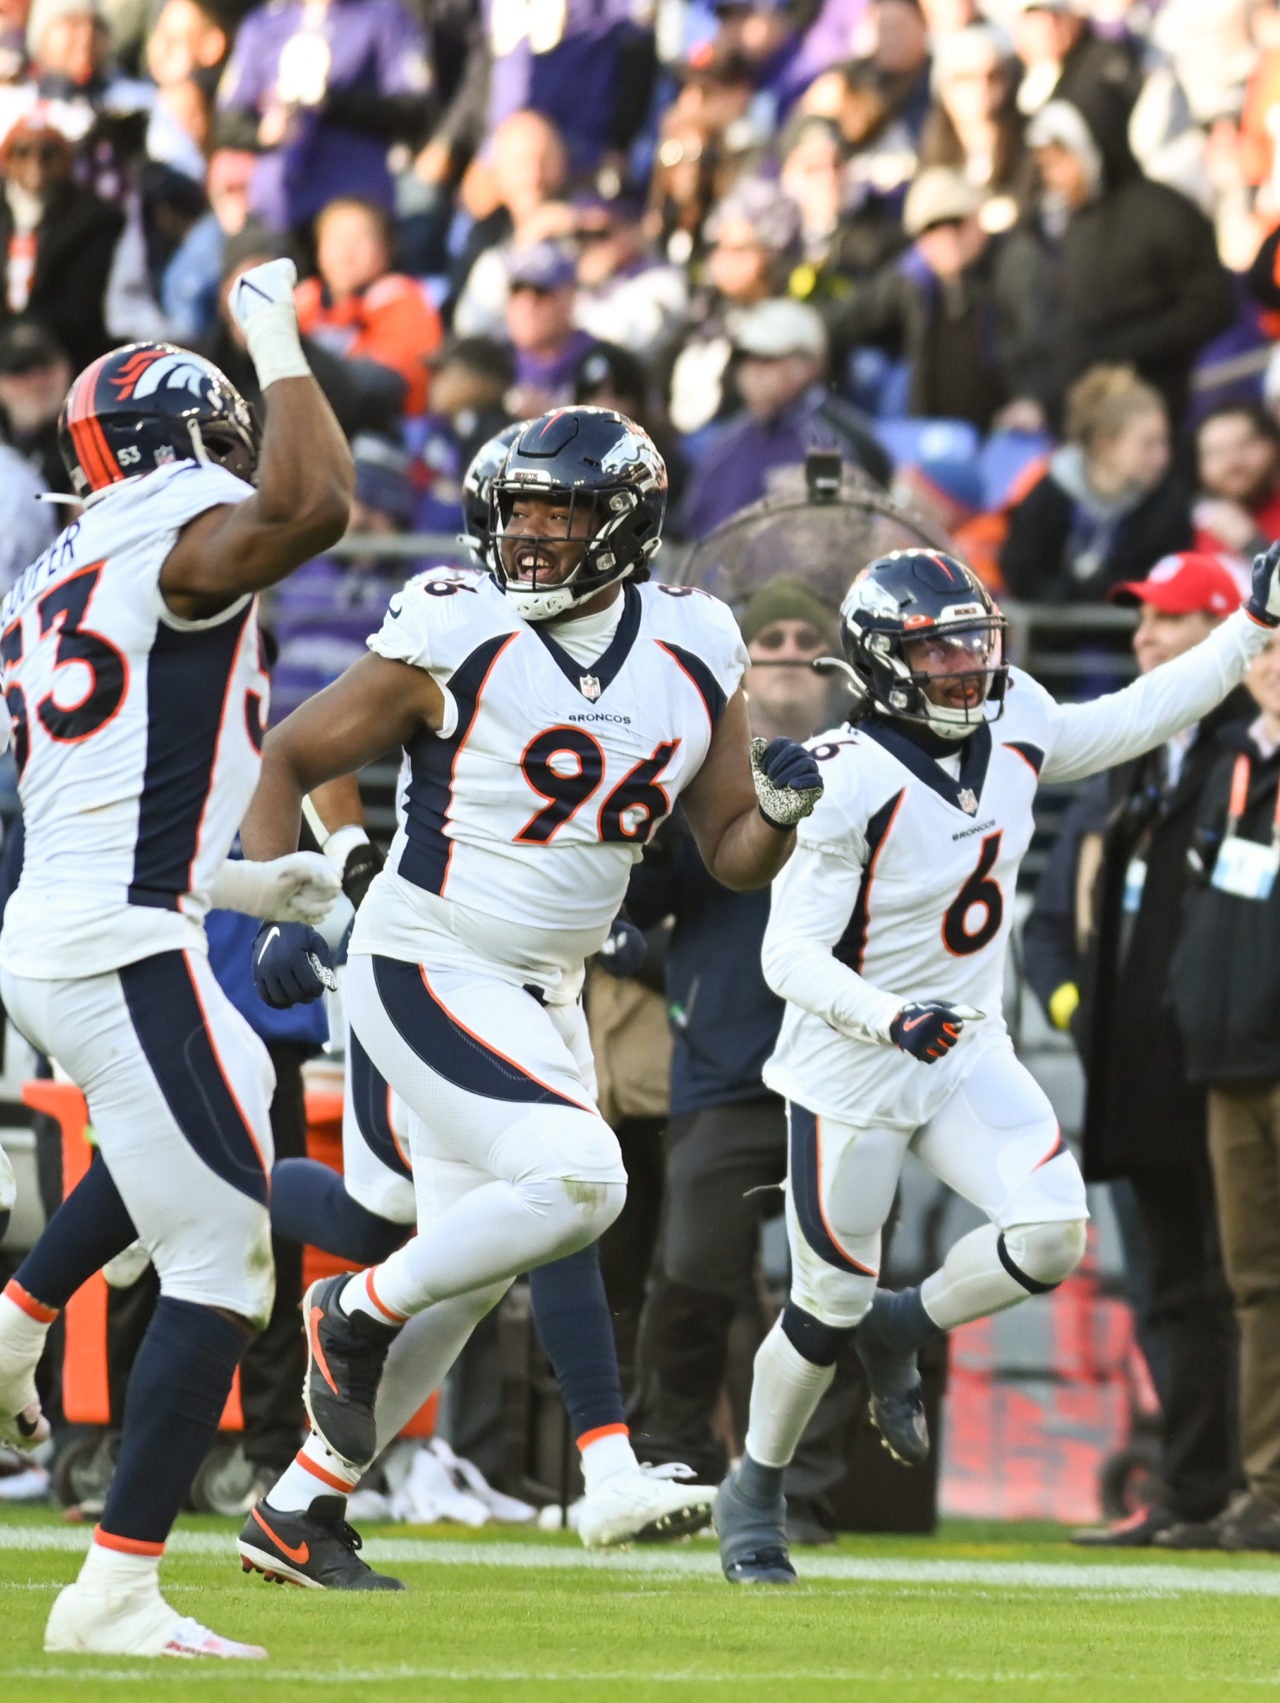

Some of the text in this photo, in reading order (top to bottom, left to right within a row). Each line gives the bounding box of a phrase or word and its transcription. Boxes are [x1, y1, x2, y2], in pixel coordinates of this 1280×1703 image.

[117, 445, 141, 467] 53
[568, 713, 632, 725] BRONCOS
[512, 724, 682, 845] 96
[952, 819, 996, 841] BRONCOS
[941, 828, 1004, 957] 6
